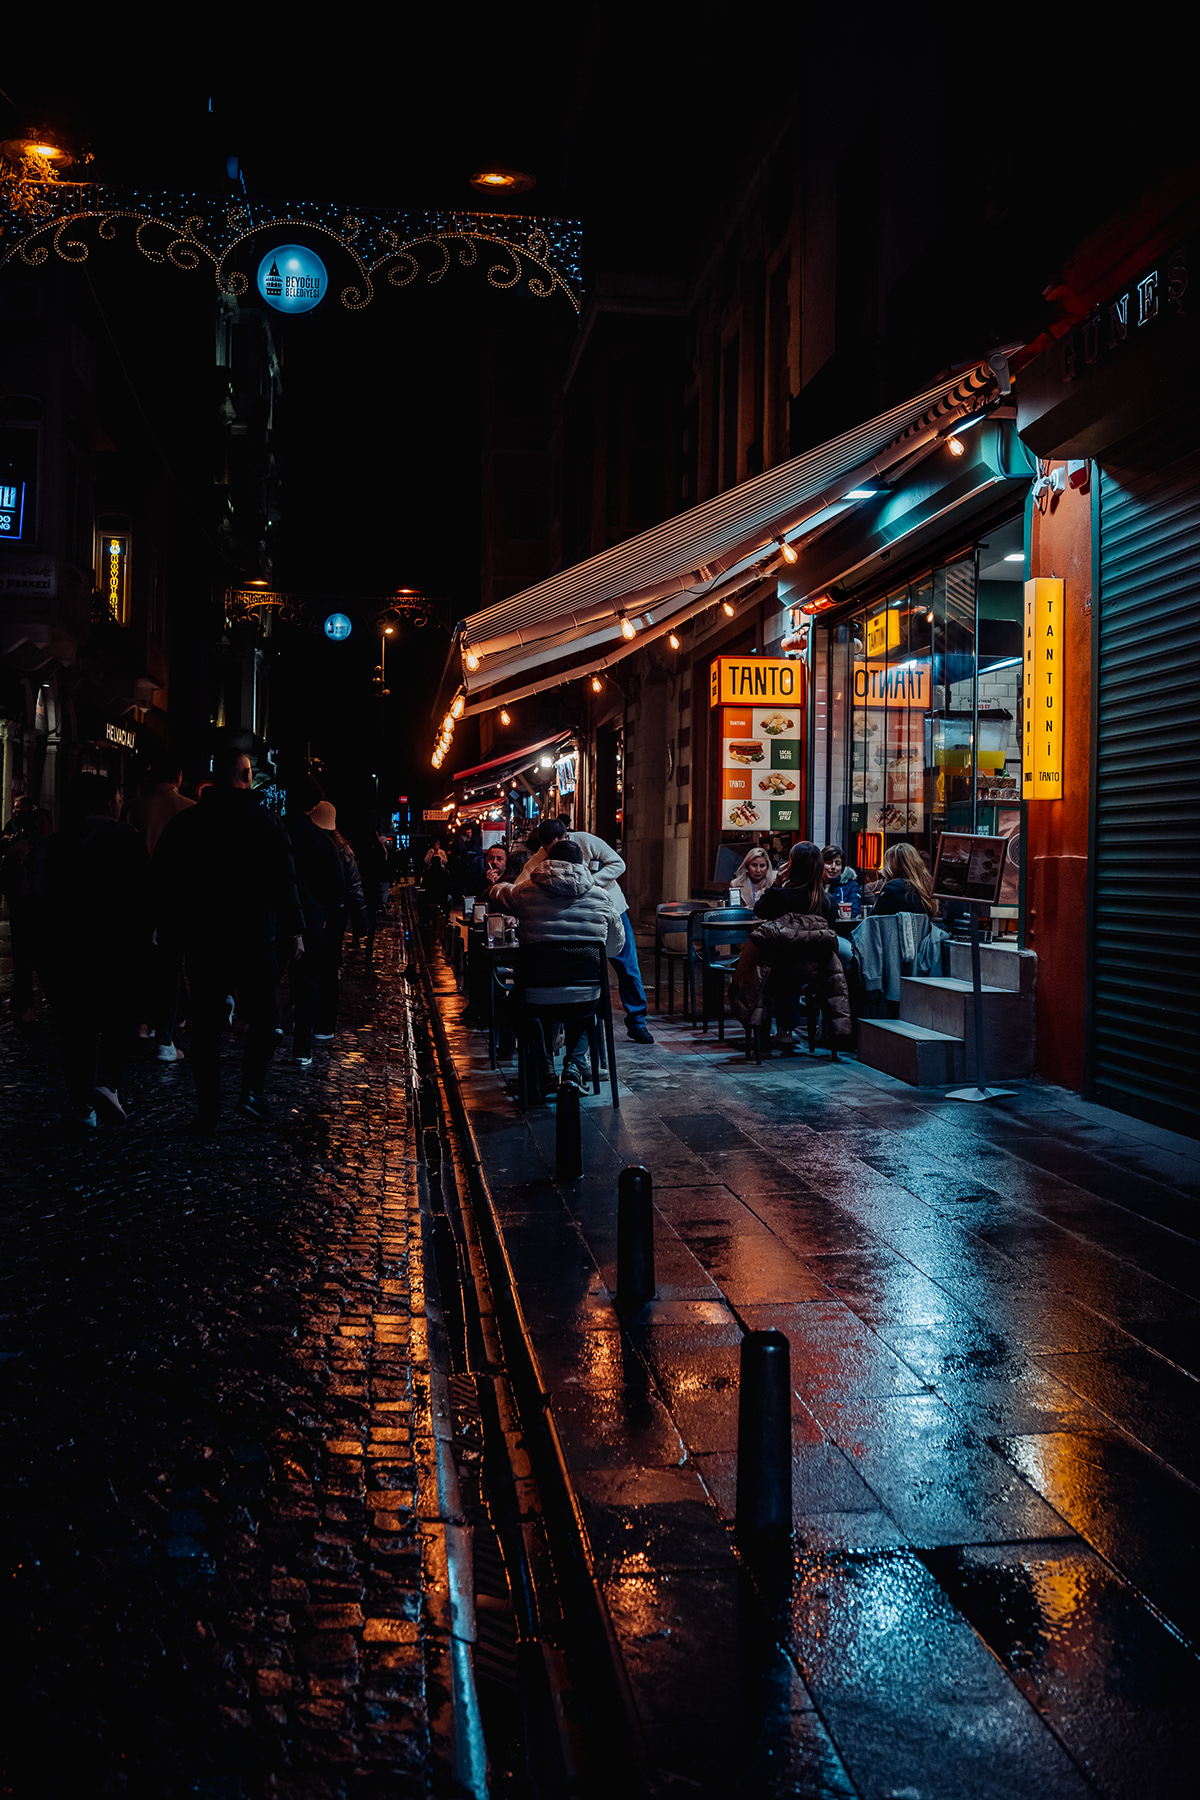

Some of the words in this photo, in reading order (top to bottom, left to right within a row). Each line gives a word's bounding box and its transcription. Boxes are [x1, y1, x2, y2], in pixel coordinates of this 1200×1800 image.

[286, 275, 320, 289] BEYOĞLU
[286, 288, 320, 299] BELEDİYESİ
[729, 666, 793, 696] TANTO
[1039, 771, 1060, 782] TANTO
[728, 780, 746, 789] TANTO
